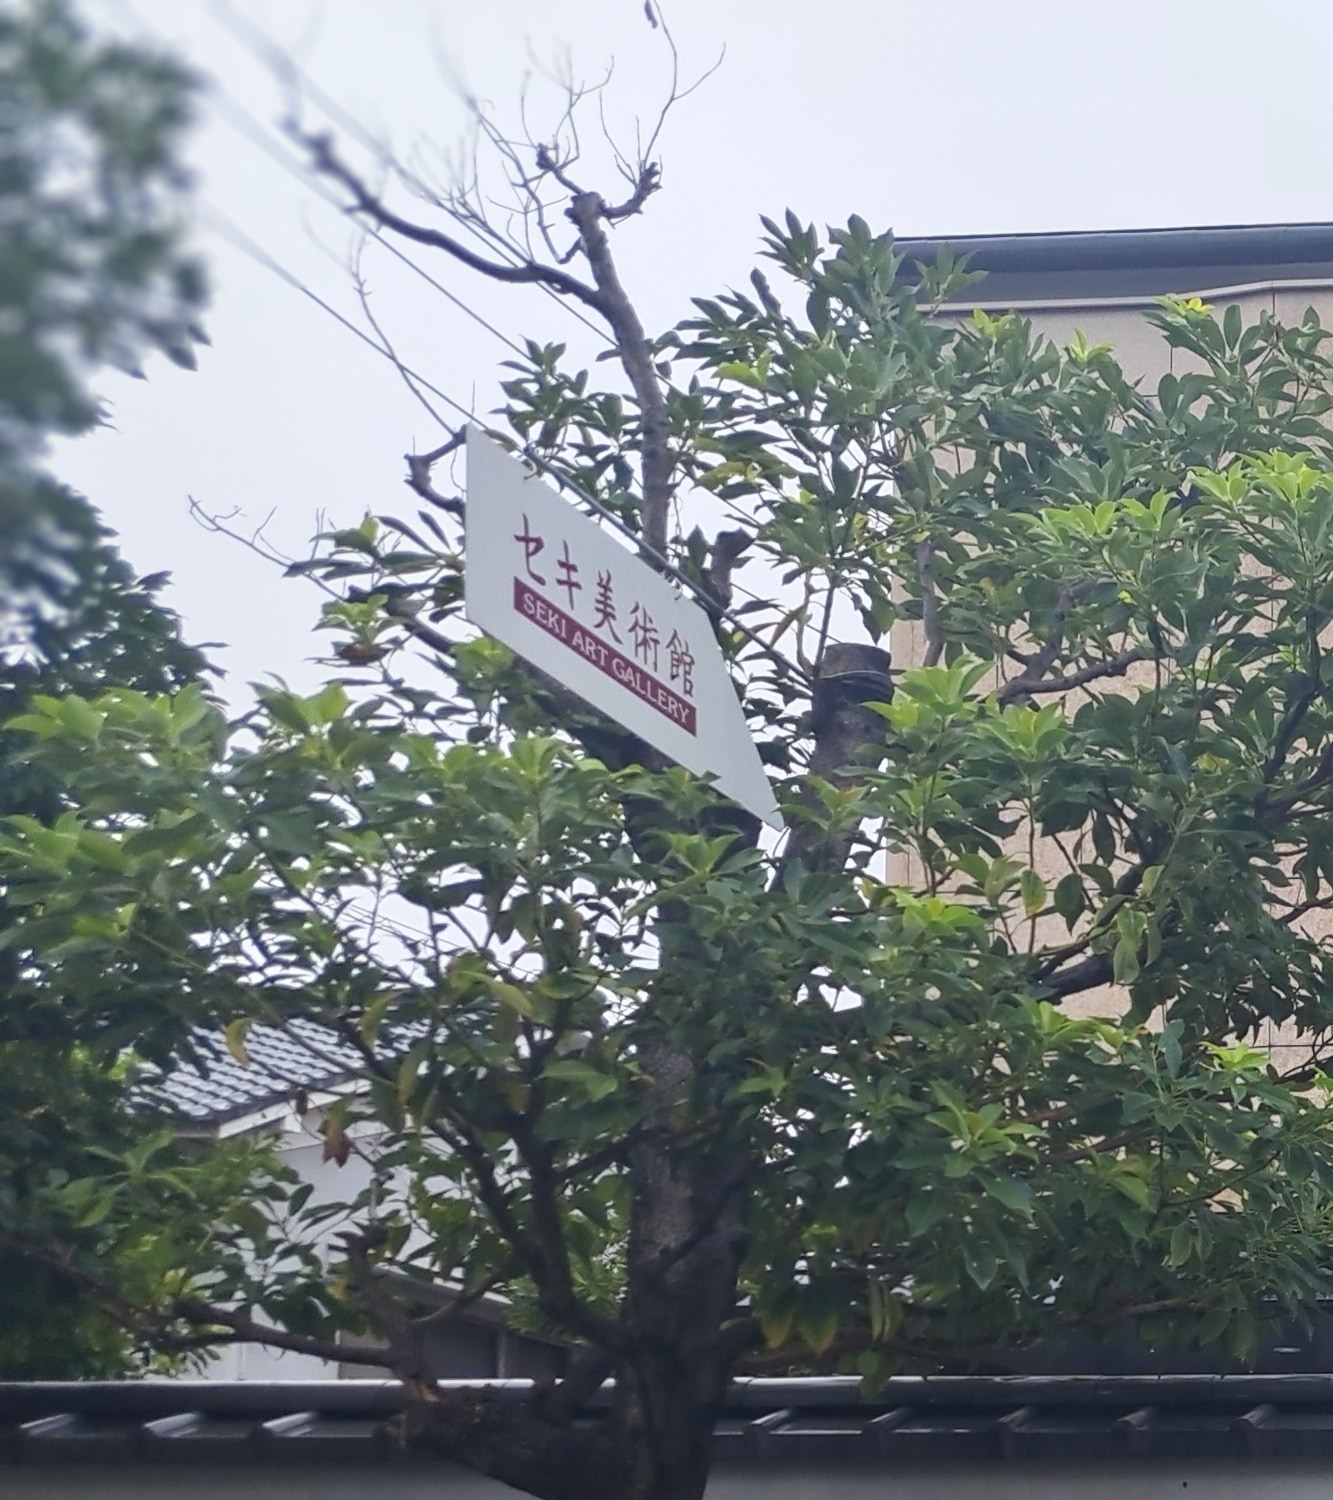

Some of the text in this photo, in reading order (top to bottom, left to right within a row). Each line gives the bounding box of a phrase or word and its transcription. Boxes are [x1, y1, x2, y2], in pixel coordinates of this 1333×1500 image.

[513, 512, 696, 698] セキ美術館
[522, 592, 691, 724] SEKI ART GALLERY
